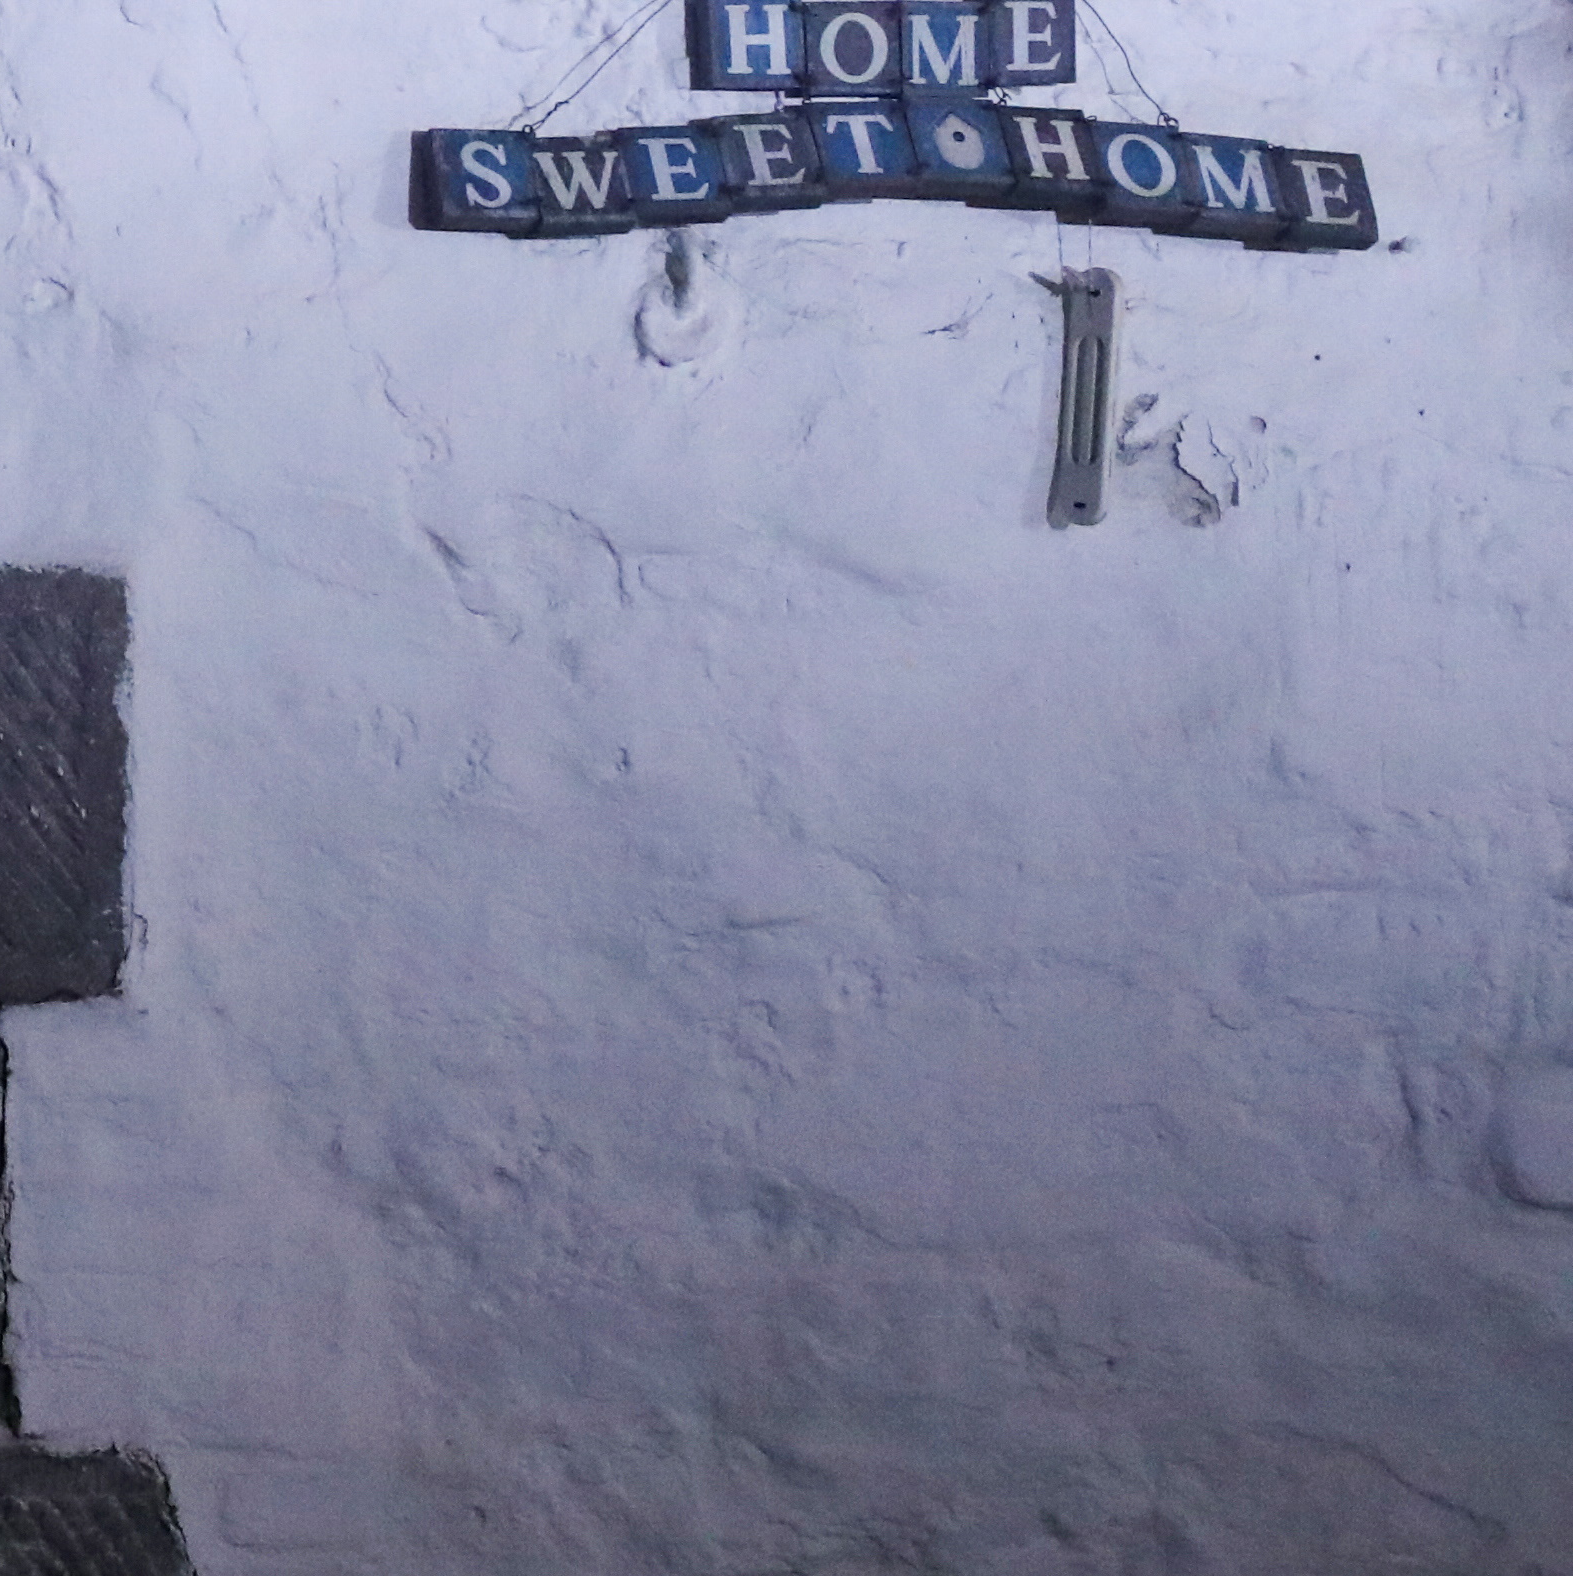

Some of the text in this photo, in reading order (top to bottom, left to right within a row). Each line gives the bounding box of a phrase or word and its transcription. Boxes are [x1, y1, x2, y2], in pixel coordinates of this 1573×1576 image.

[722, 0, 1062, 88] HOME
[459, 113, 1360, 225] SWEET HOME
